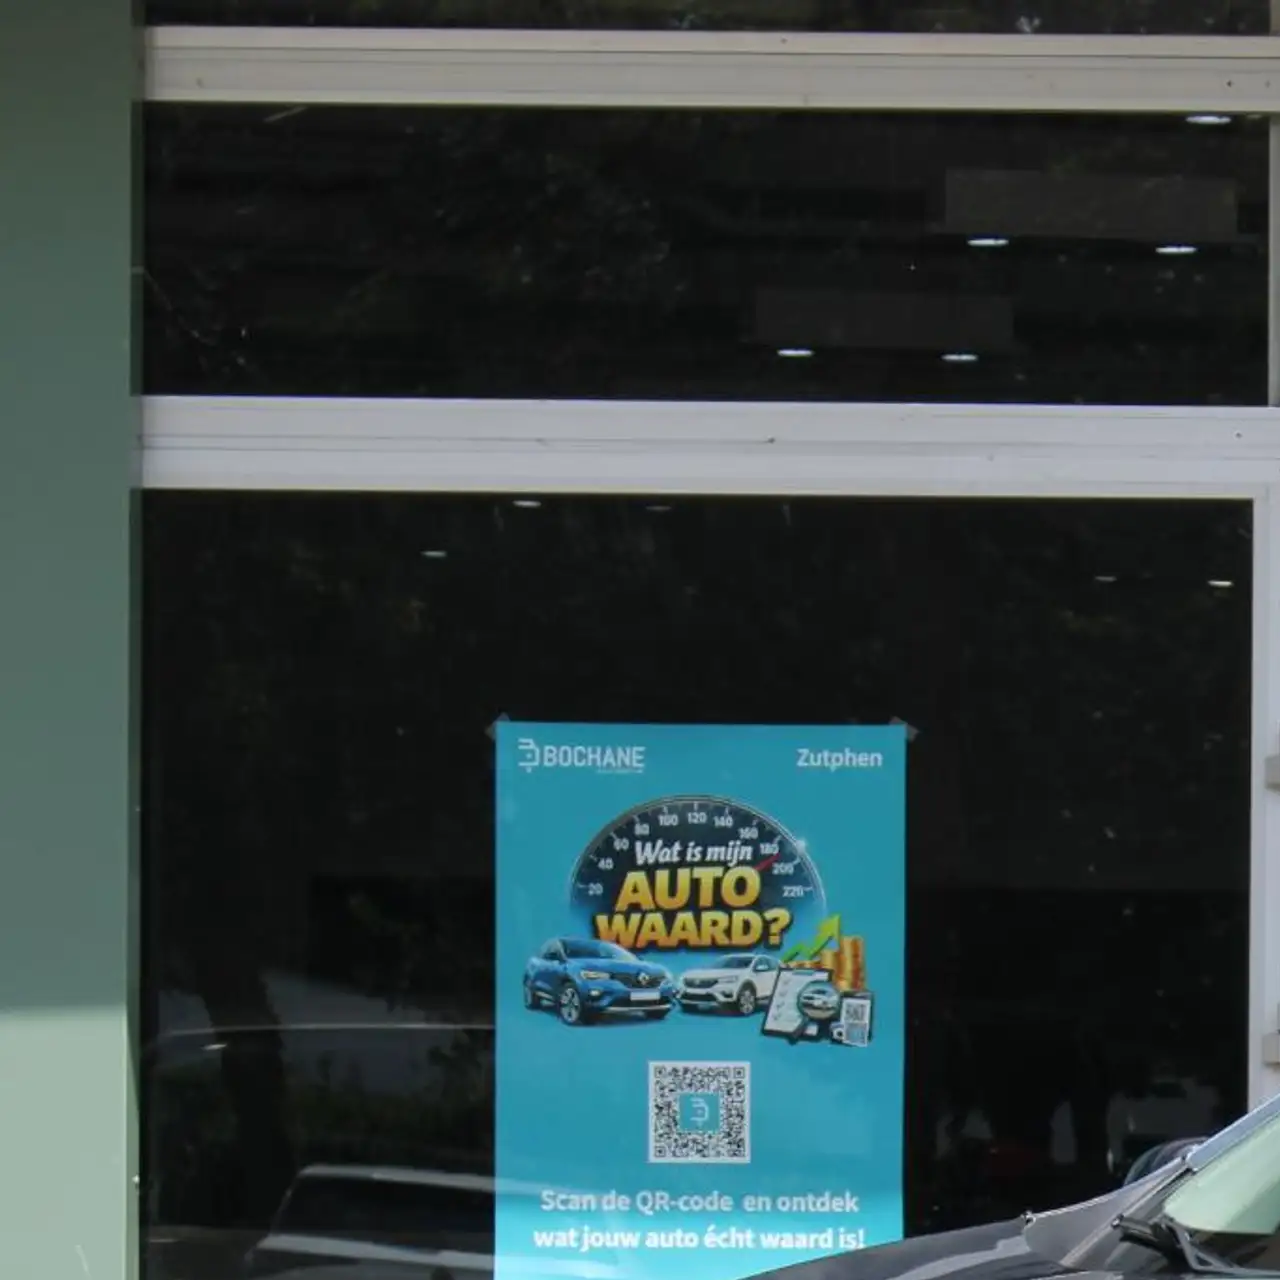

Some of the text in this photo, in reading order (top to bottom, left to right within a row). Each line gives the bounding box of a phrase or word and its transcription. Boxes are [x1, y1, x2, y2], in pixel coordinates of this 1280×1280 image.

[543, 746, 645, 767] BOCHANE
[796, 748, 882, 771] Zutphen
[634, 839, 753, 866] Wat is mijn
[614, 866, 760, 912] AUTO
[595, 907, 791, 948] WAARD?
[540, 1190, 859, 1215] Scan de QR-code en ontdek
[534, 1225, 866, 1252] wat jouw auto écht waard is!
